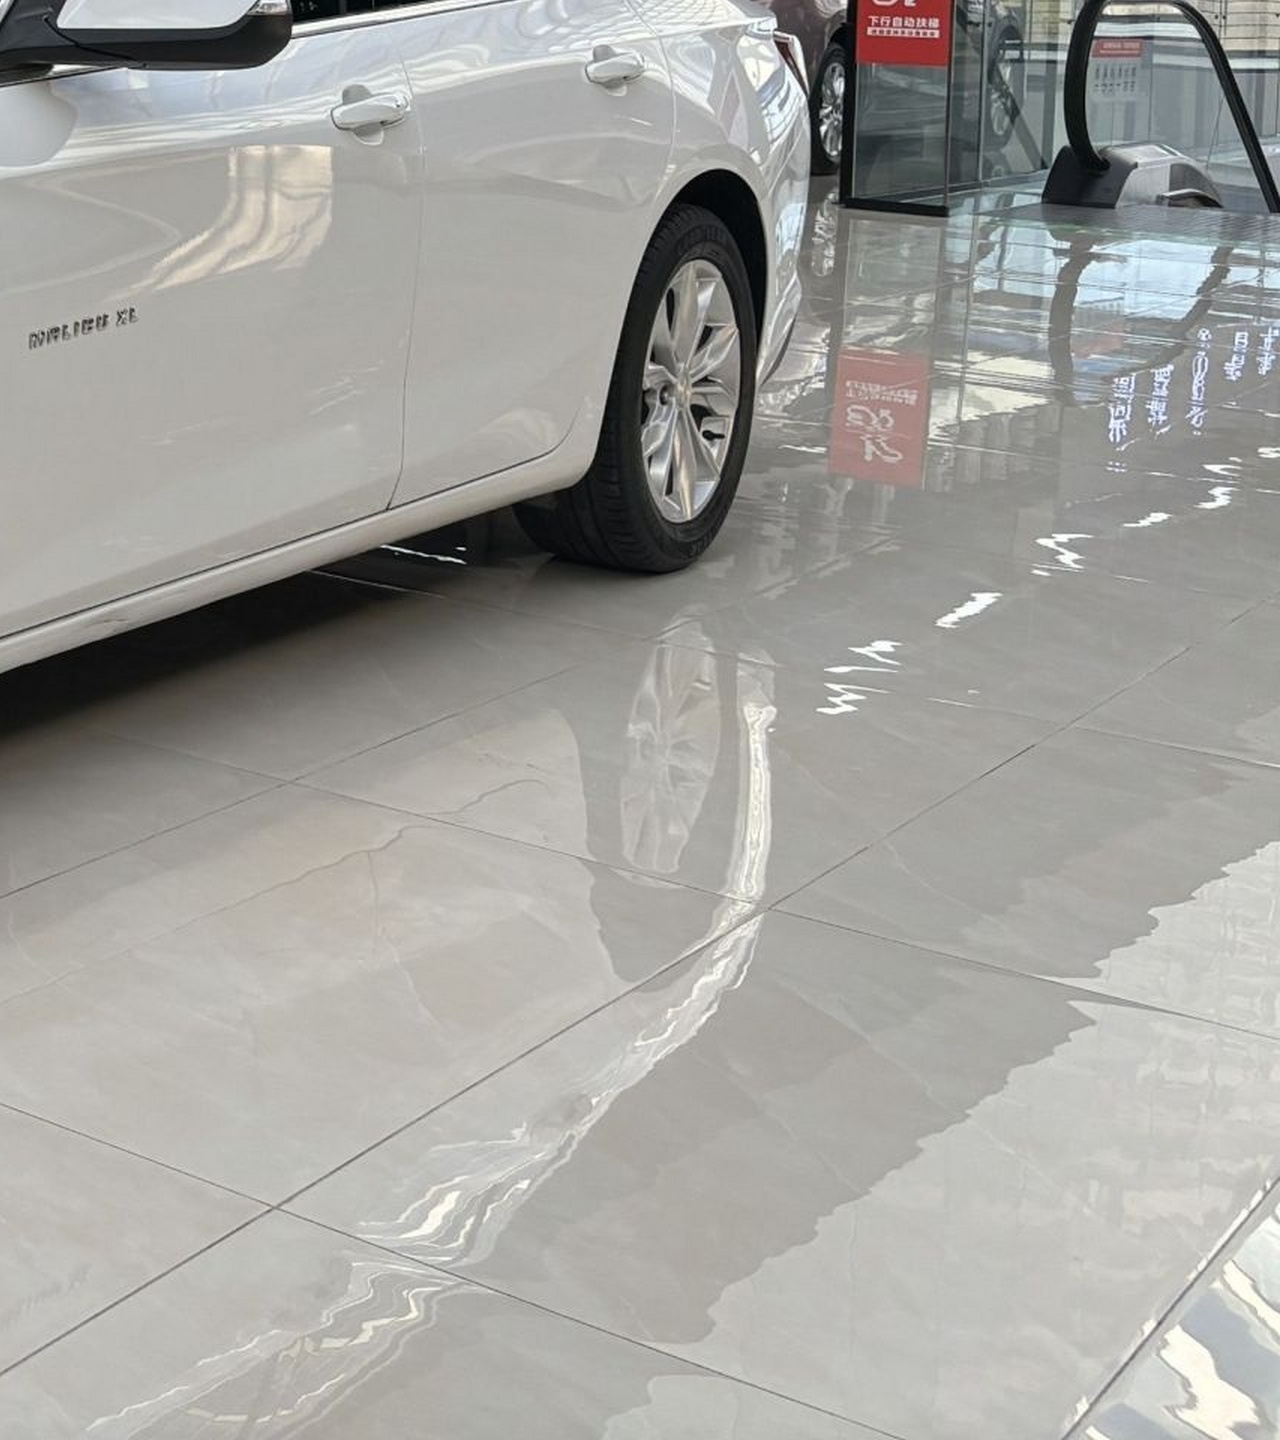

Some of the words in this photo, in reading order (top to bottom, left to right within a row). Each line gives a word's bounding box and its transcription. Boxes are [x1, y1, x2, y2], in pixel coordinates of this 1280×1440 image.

[868, 15, 939, 27] 下行自动扶梯
[116, 307, 137, 327] XL
